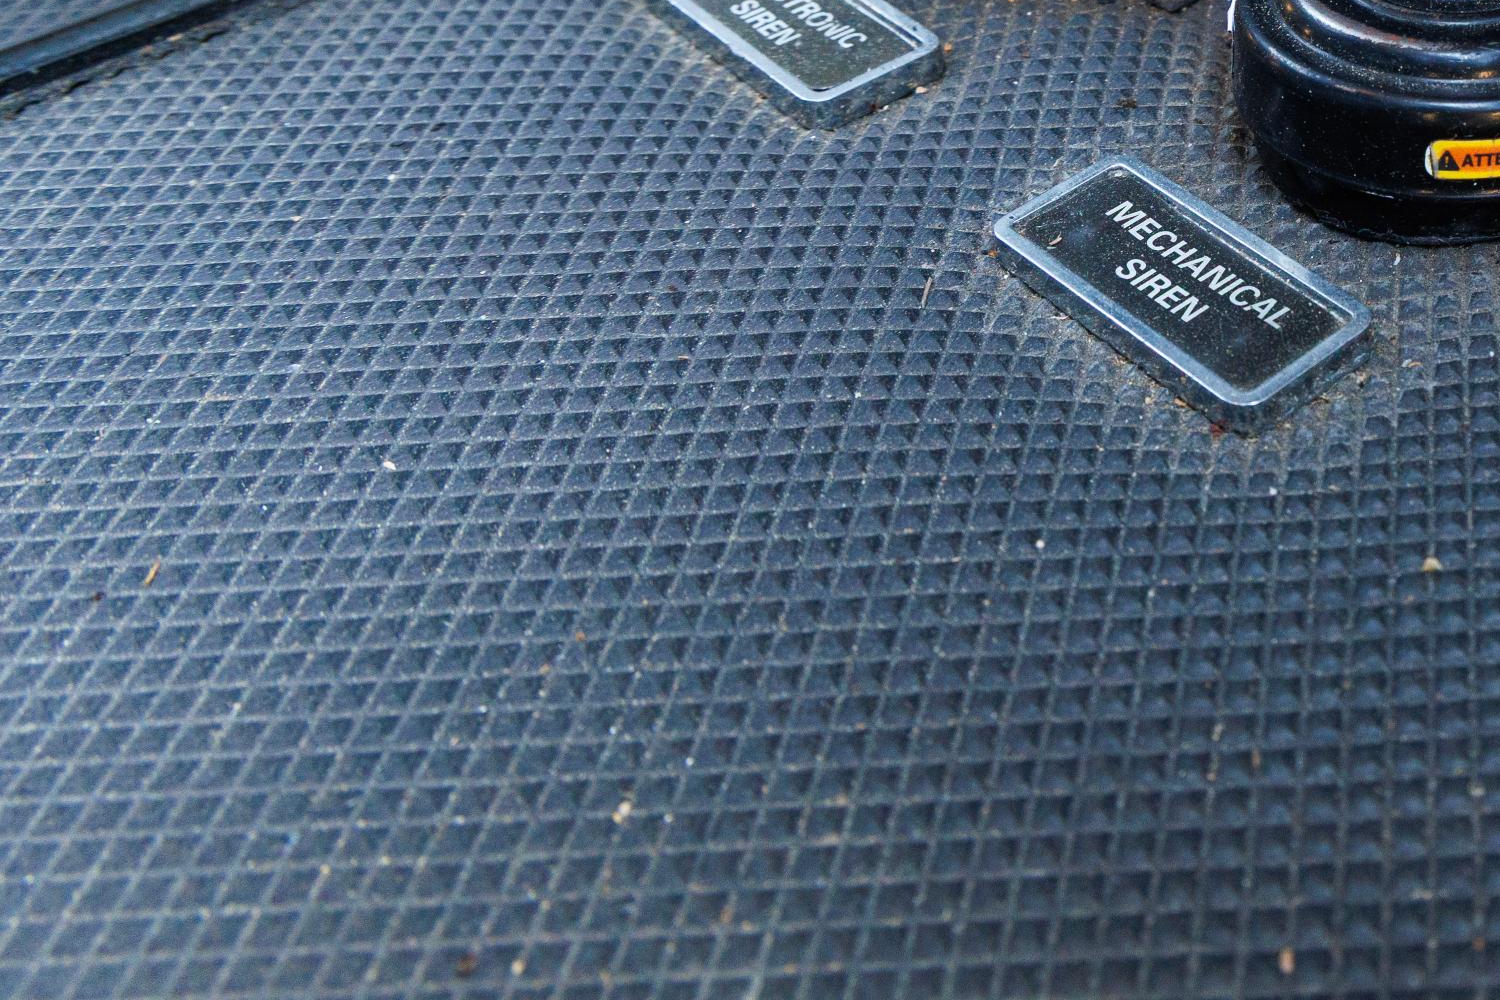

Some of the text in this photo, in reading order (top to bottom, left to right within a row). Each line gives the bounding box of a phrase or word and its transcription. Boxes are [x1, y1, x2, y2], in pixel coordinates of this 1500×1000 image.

[730, 0, 803, 47] SIREN
[1105, 200, 1292, 330] MECHANICAL
[1115, 258, 1210, 324] SIREN
